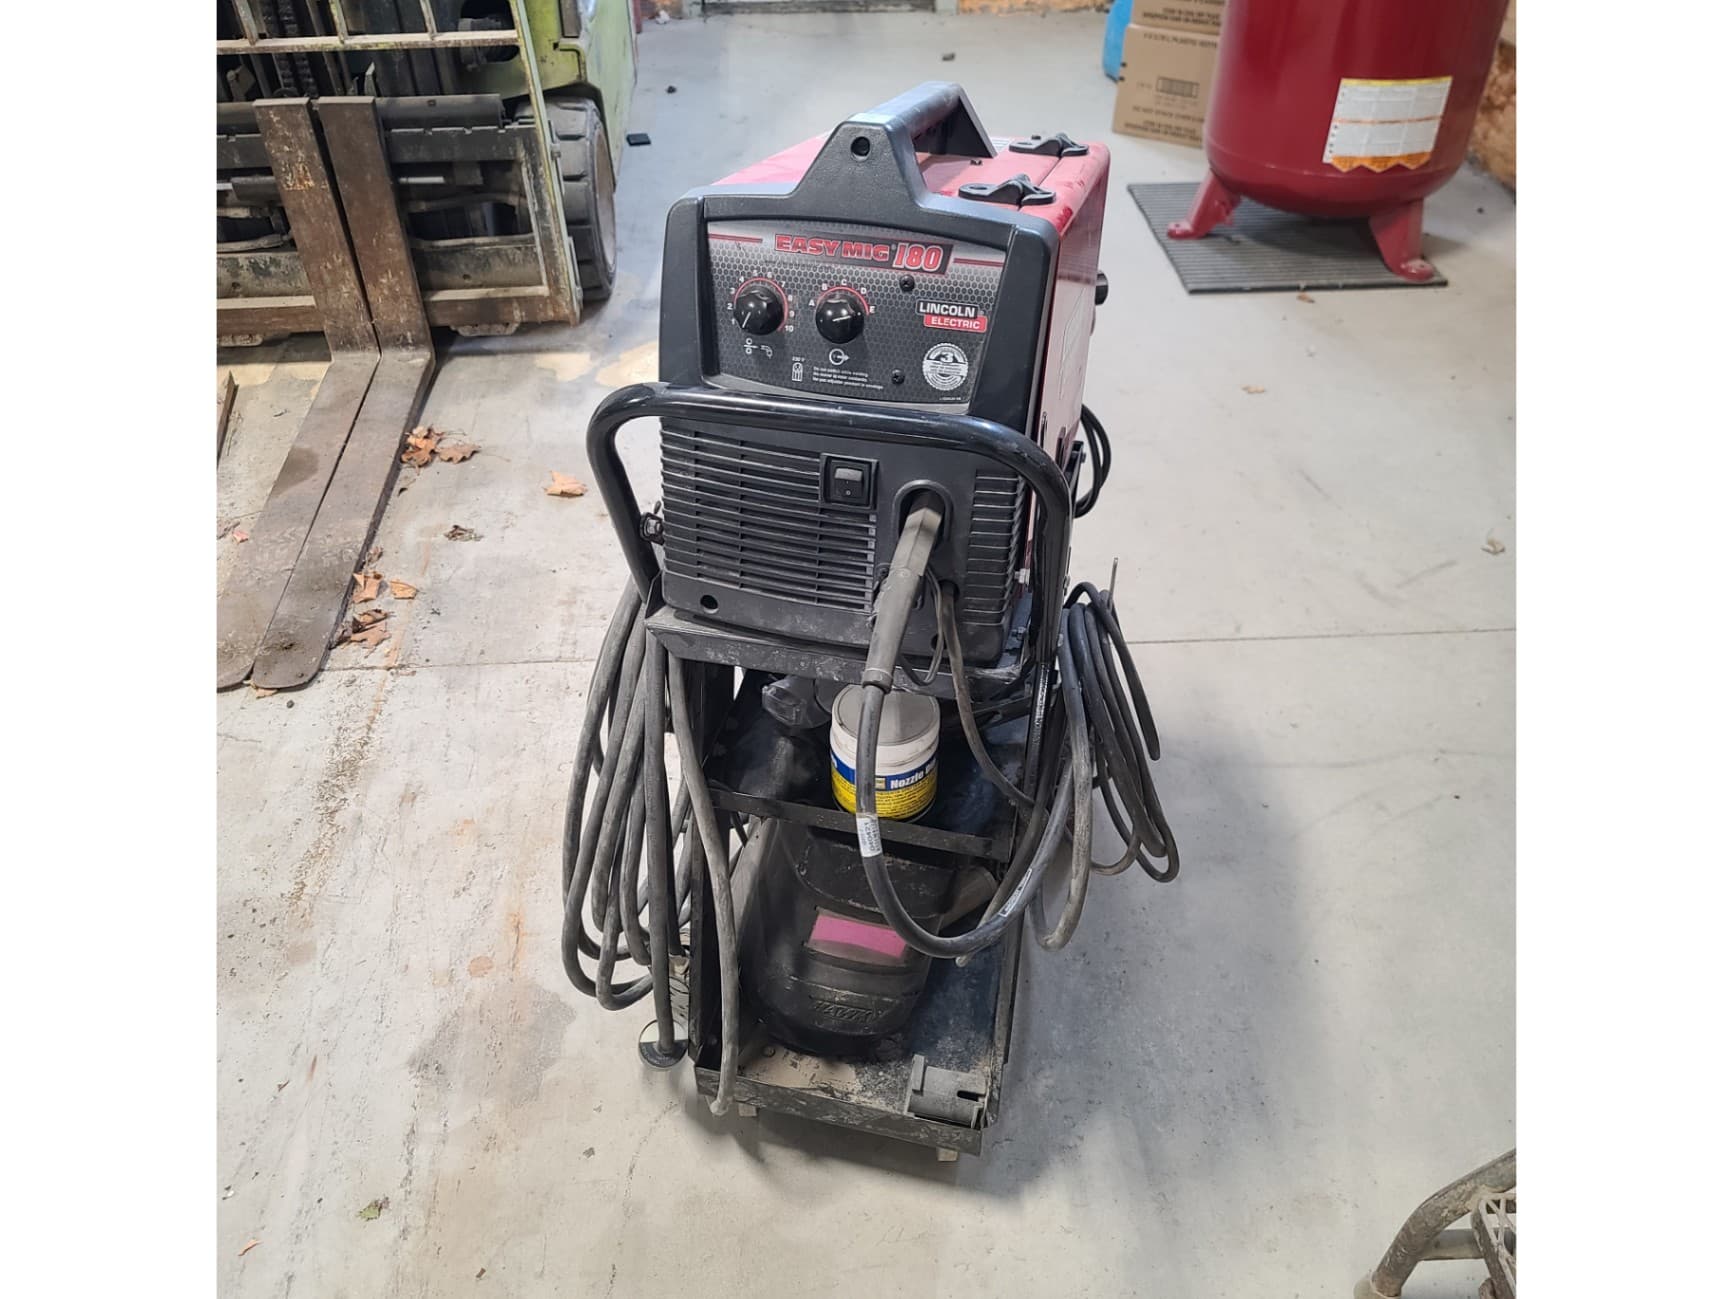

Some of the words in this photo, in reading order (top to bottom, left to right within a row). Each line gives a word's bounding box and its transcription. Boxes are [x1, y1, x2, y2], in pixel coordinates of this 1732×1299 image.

[775, 234, 841, 257] EASY
[842, 241, 890, 262] MIG
[892, 242, 944, 272] 180
[727, 302, 734, 310] 2
[808, 299, 815, 307] A
[869, 305, 876, 314] E
[919, 301, 976, 318] LINCOLN
[784, 325, 794, 333] 10
[931, 316, 981, 330] ELECTRIC
[940, 351, 954, 363] 3
[890, 770, 924, 790] Nozzle
